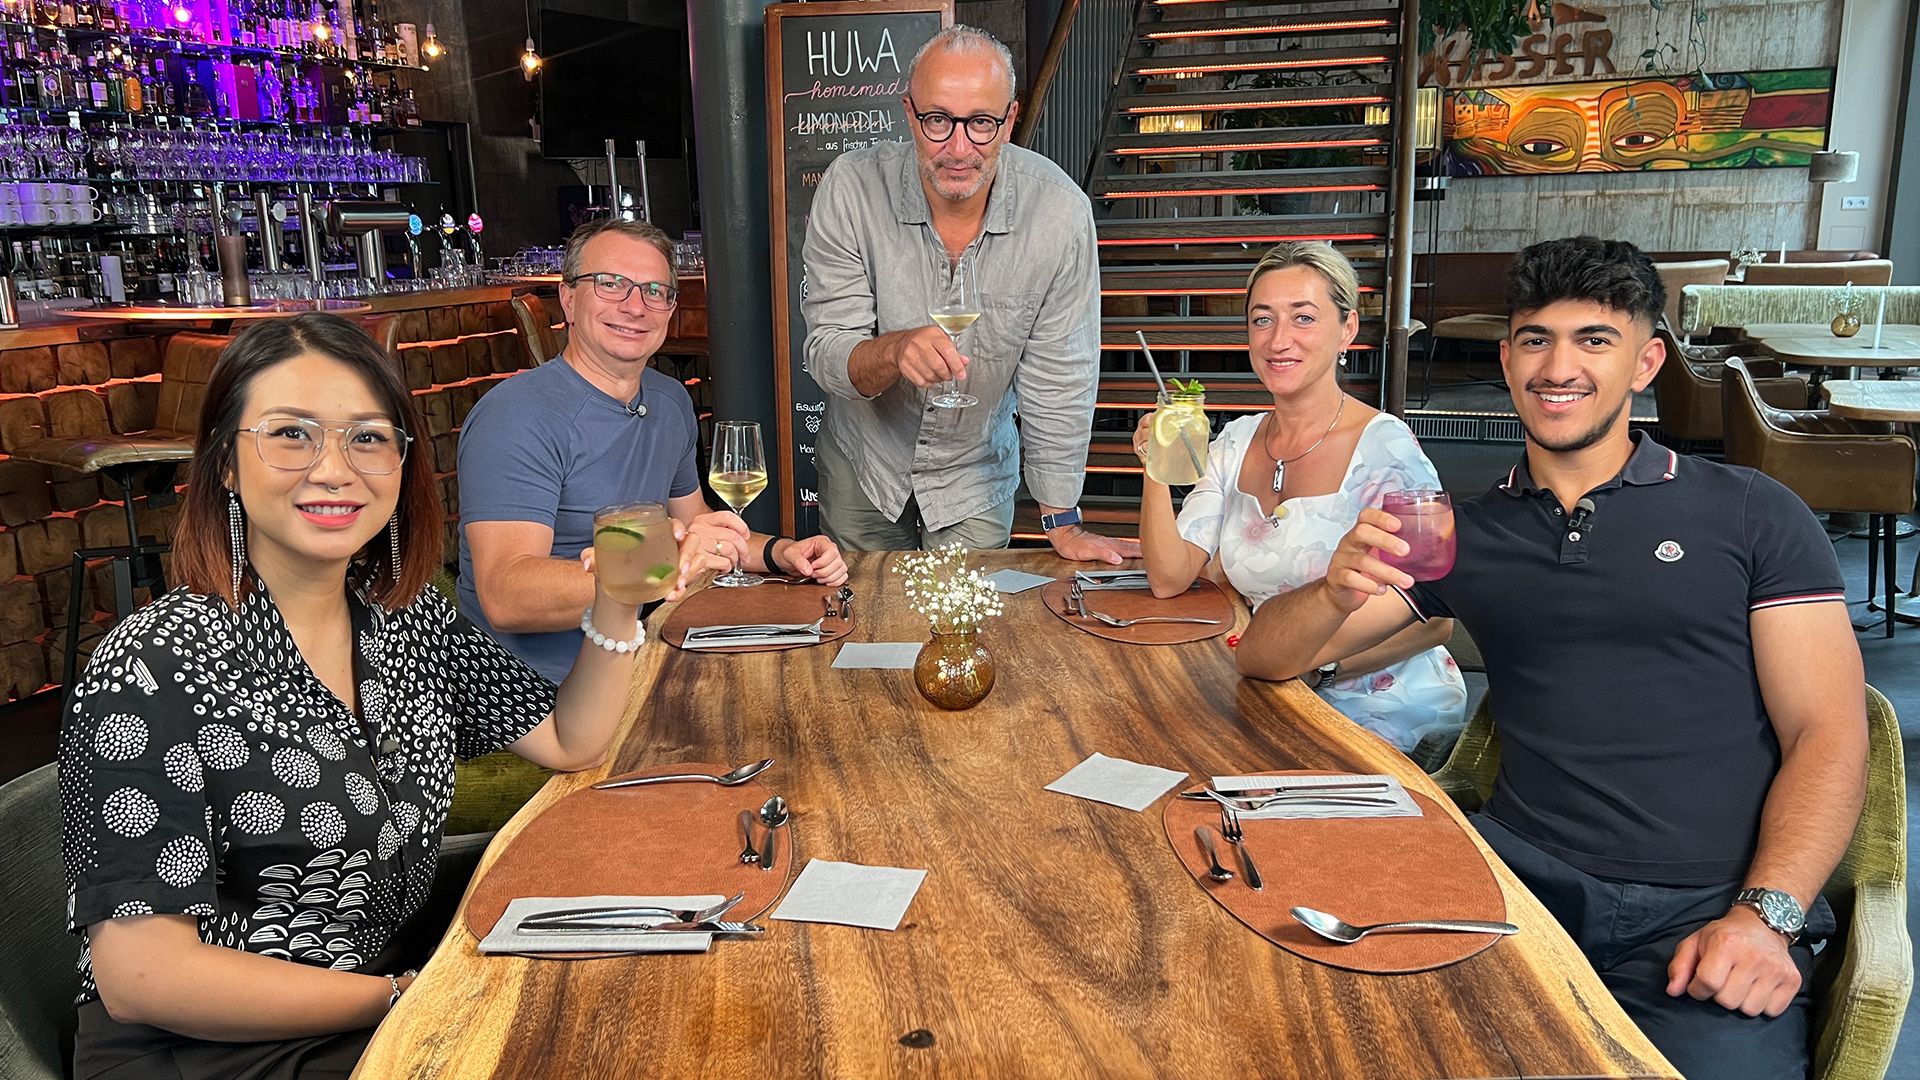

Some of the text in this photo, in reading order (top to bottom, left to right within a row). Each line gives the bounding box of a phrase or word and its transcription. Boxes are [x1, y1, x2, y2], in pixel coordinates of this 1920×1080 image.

[807, 27, 901, 76] HUWA
[798, 109, 892, 135] LIMONADEN
[825, 141, 838, 151] aus
